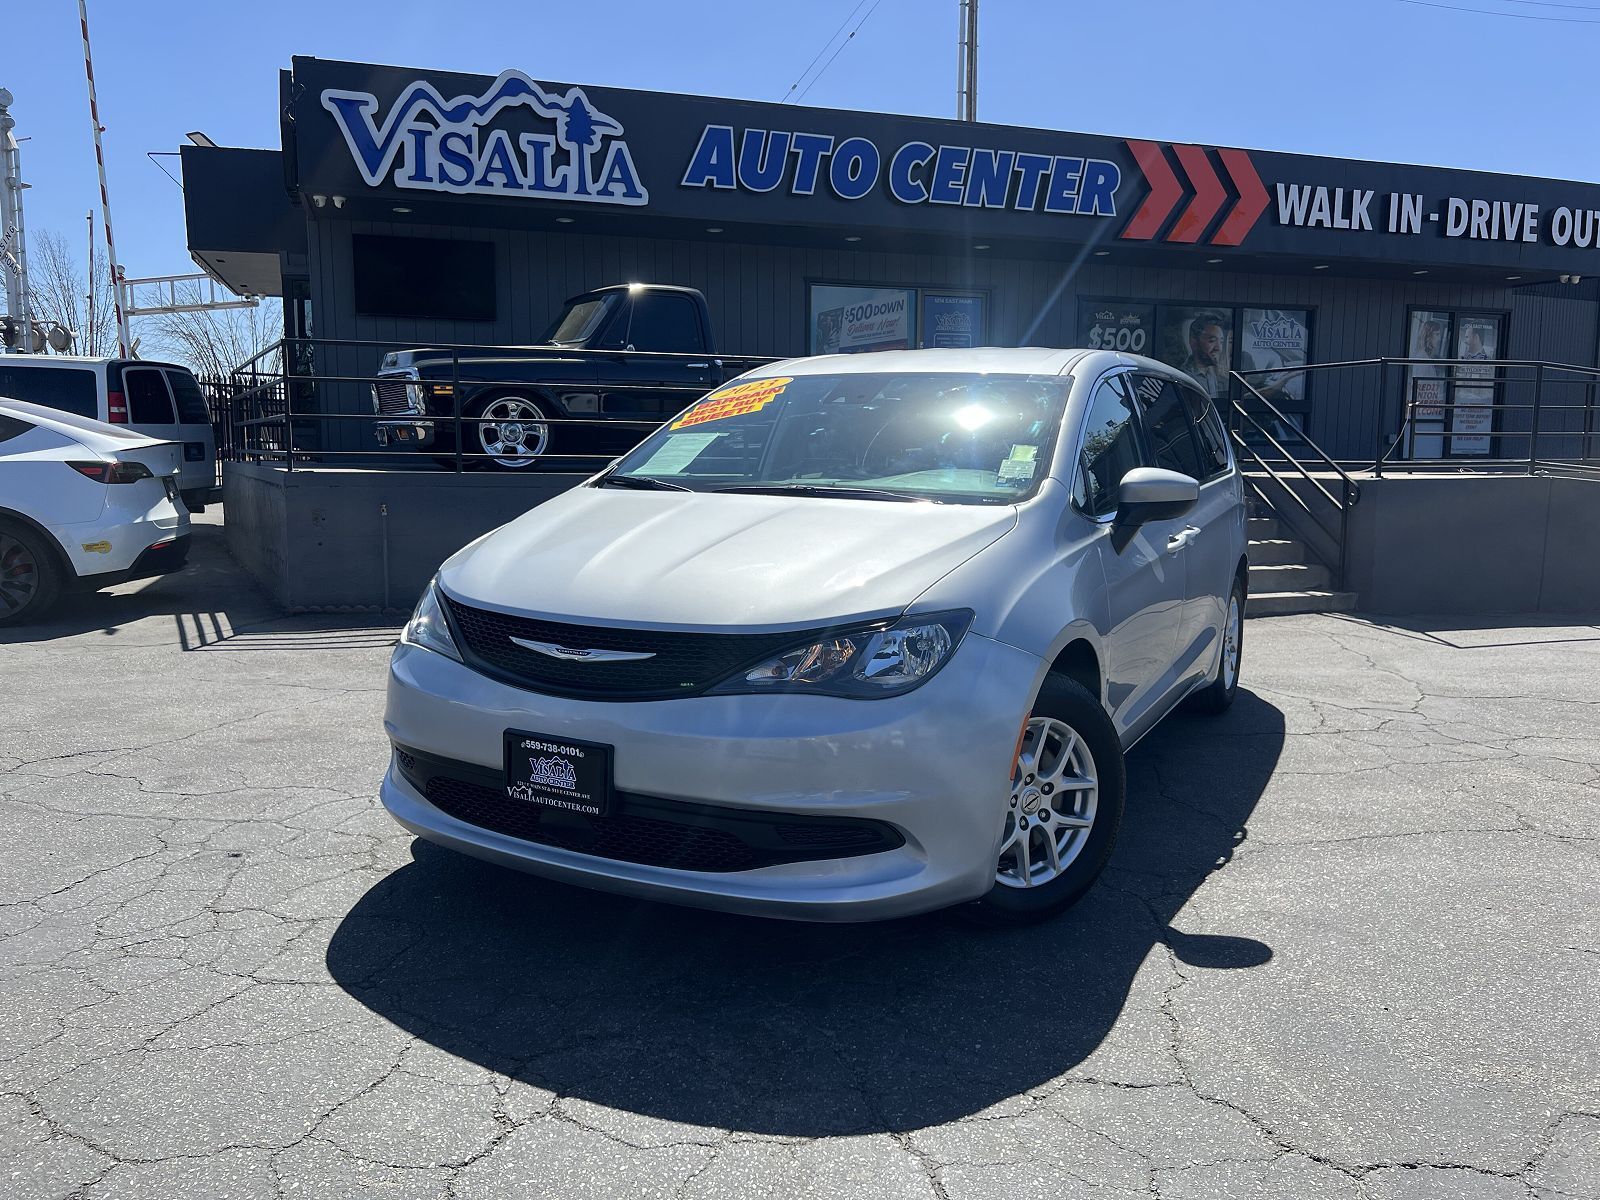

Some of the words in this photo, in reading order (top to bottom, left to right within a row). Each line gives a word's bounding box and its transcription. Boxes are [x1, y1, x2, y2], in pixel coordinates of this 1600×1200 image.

[322, 80, 648, 205] VISALIA
[681, 123, 881, 199] AUTO
[889, 141, 1121, 217] CENTER
[1276, 182, 1375, 231] WALK
[1388, 192, 1423, 234] IN
[1446, 197, 1539, 242] DRIVE
[844, 303, 873, 323] $500
[873, 299, 905, 316] DOWN
[1088, 323, 1146, 351] $500
[1251, 318, 1302, 339] VISALIA
[687, 403, 732, 419] BEST
[732, 395, 769, 408] BUY
[696, 386, 783, 411] BARGAIN
[679, 405, 757, 427] SWEET!
[525, 740, 581, 757] 559-738-0101
[529, 756, 577, 781] VISALIA
[548, 777, 576, 790] CENTER
